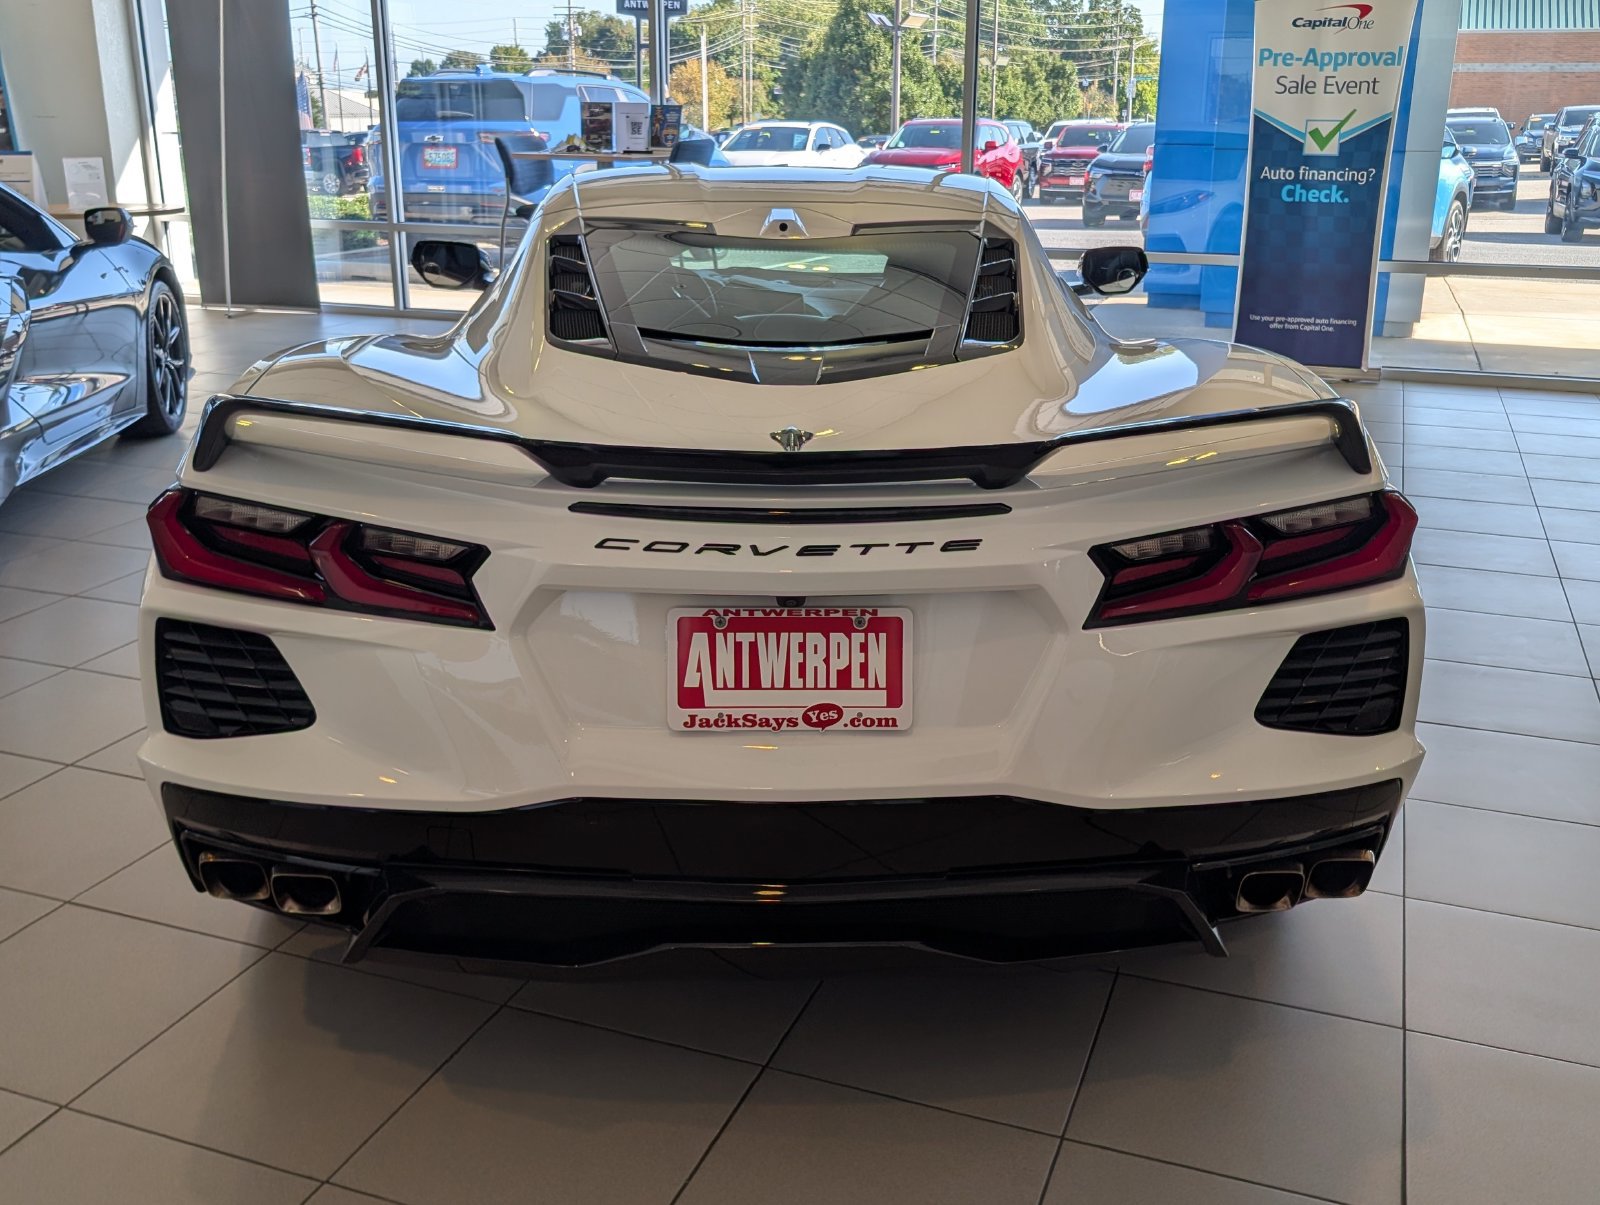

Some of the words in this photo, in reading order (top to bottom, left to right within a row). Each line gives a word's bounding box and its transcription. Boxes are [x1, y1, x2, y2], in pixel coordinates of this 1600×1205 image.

[1258, 46, 1404, 72] Pre-Approval
[1274, 74, 1317, 95] Sale
[1323, 76, 1380, 96] Event
[1260, 166, 1295, 180] Auto
[1299, 166, 1376, 185] financing?
[1281, 184, 1349, 203] Check.
[1261, 315, 1274, 323] your
[1275, 316, 1314, 324] pre-approved
[1329, 318, 1357, 326] financing
[1300, 323, 1320, 332] Capital
[594, 537, 983, 556] CORVETTE
[702, 608, 879, 617] ANTWERPEN
[683, 632, 888, 692] ANTWERPEN
[683, 713, 799, 731] JackSays
[806, 709, 839, 723] Yes
[843, 715, 898, 728] .com
